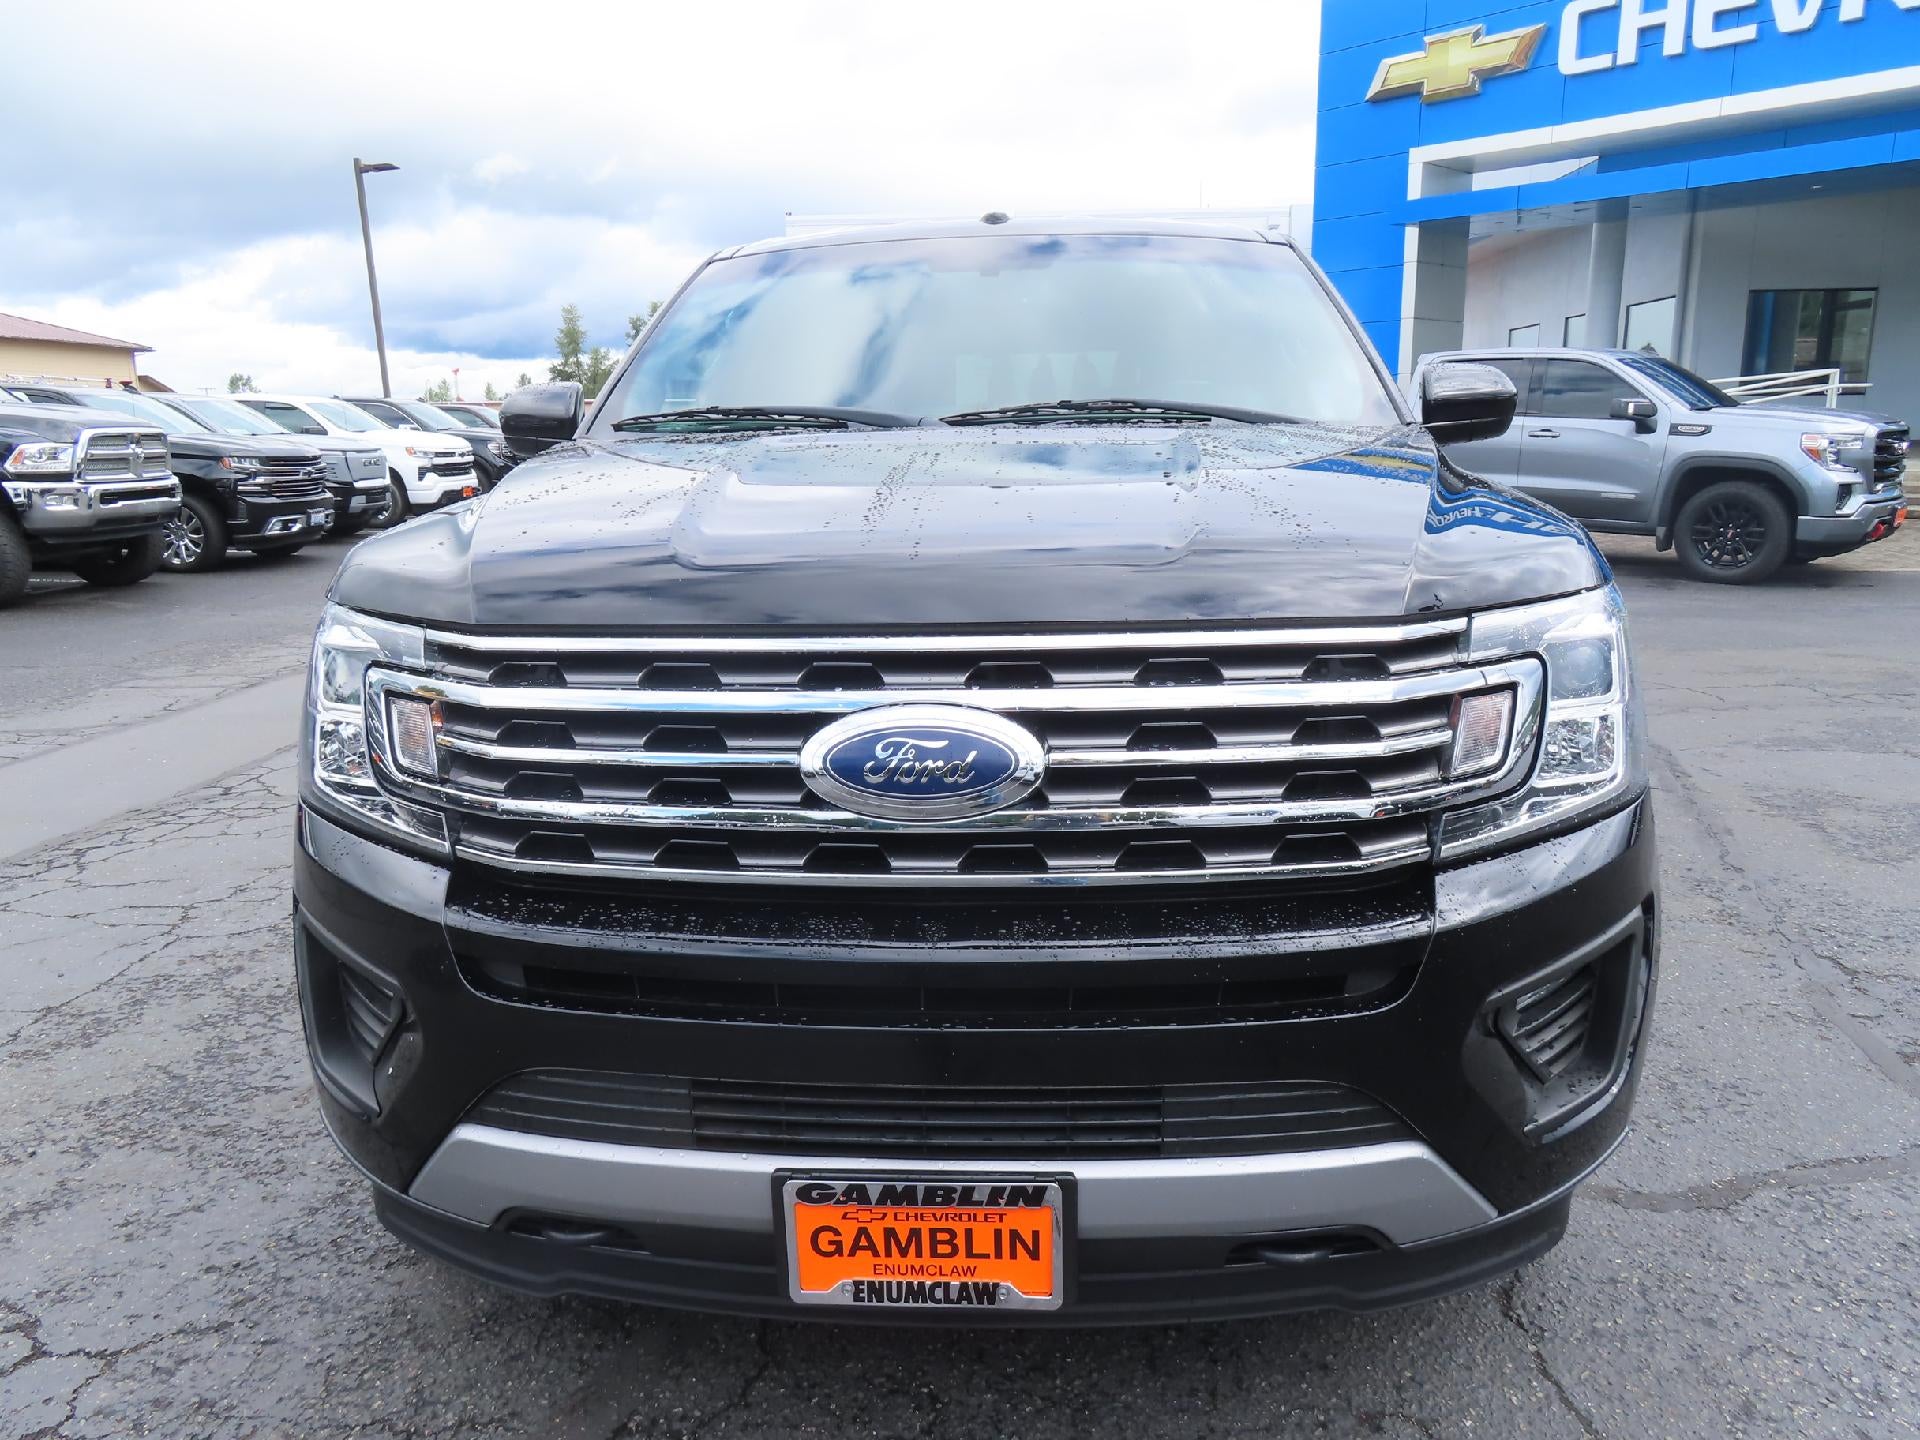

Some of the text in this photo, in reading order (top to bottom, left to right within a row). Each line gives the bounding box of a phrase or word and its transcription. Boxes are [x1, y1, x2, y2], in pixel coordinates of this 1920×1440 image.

[864, 737, 978, 784] Ford
[795, 1182, 1049, 1207] GAMBLIN
[893, 1211, 1007, 1223] CHEVROLET
[810, 1225, 1041, 1261] GAMBLIN
[873, 1263, 978, 1277] ENUMCLAW
[853, 1280, 1001, 1306] ENUMCLAW
